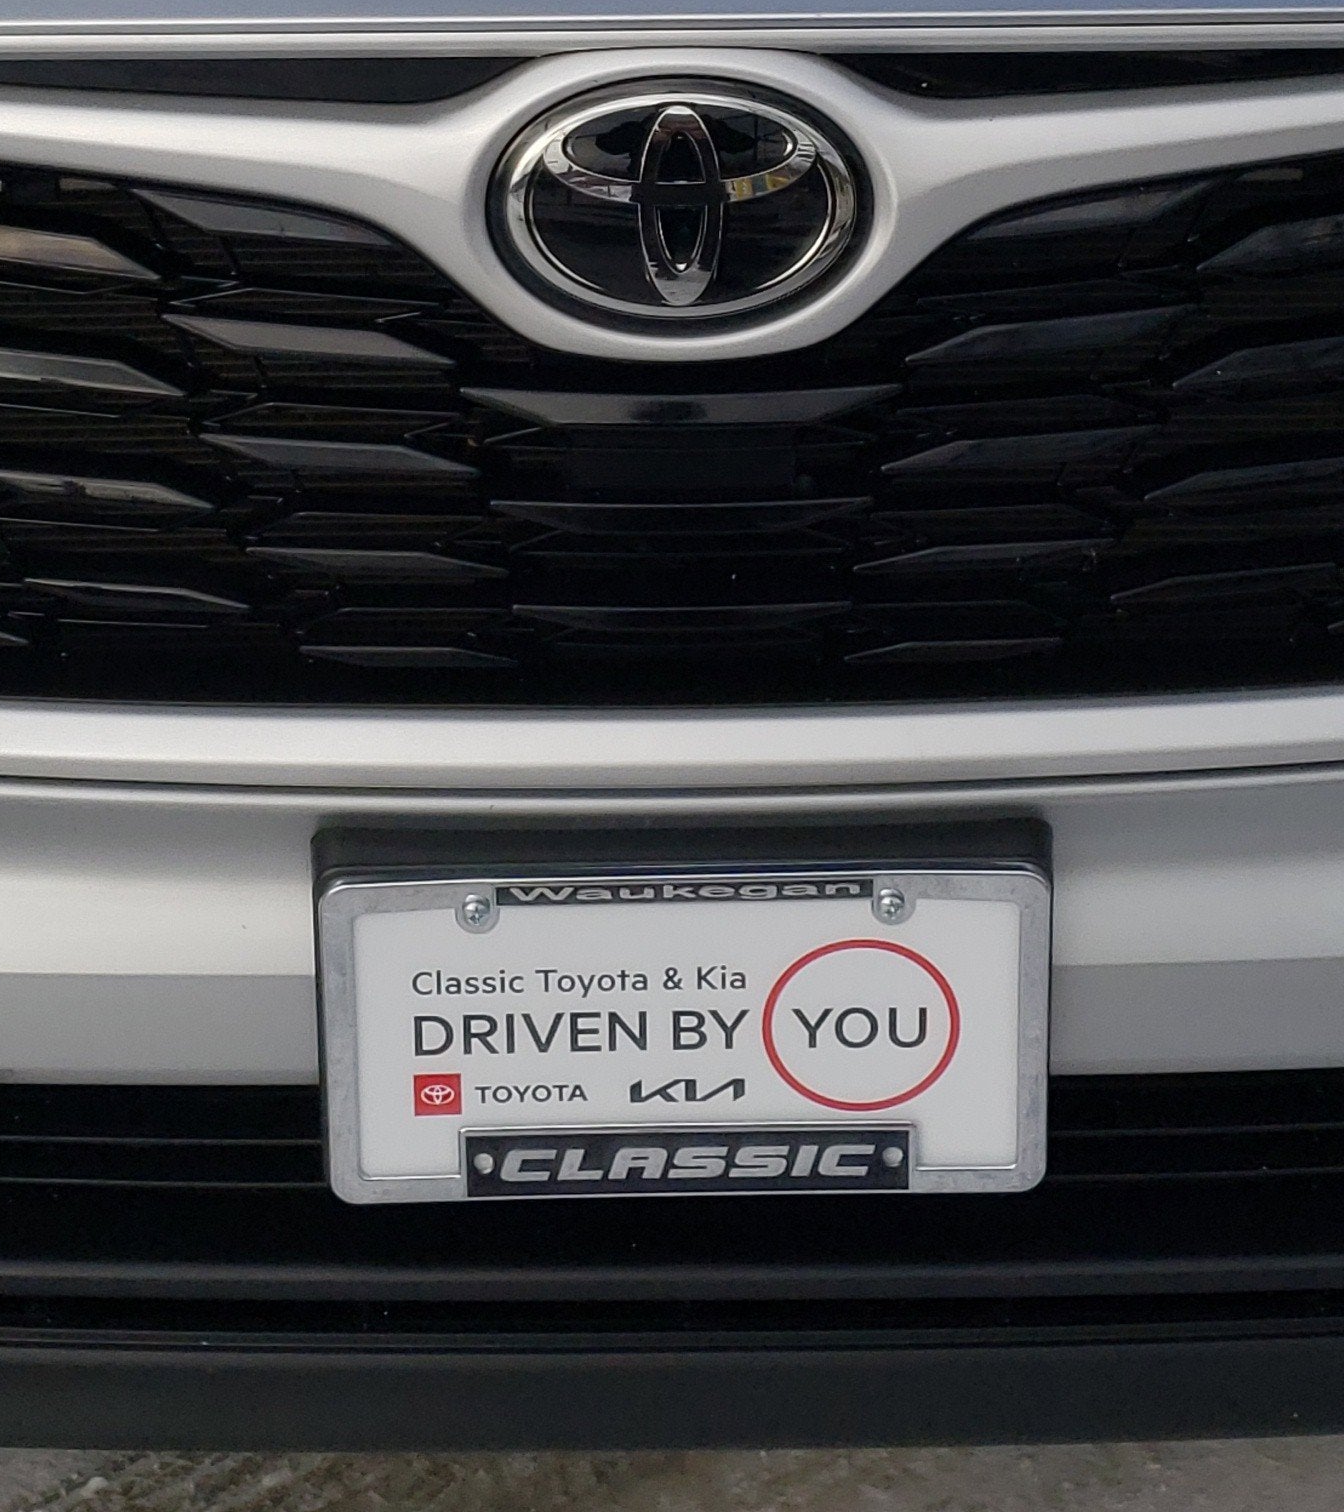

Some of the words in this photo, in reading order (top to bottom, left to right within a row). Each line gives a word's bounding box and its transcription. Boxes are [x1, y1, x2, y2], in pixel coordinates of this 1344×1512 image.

[509, 882, 861, 902] Waukegan
[412, 970, 524, 995] Classic
[535, 969, 648, 998] Toyota
[662, 967, 683, 990] &
[697, 965, 747, 989] Kia
[413, 1011, 648, 1056] DRIVEN
[672, 1009, 750, 1051] BY
[792, 1007, 928, 1049] YOU
[474, 1084, 588, 1104] TOYOTA
[629, 1078, 746, 1103] KIA
[500, 1143, 876, 1182] CLASSIC
